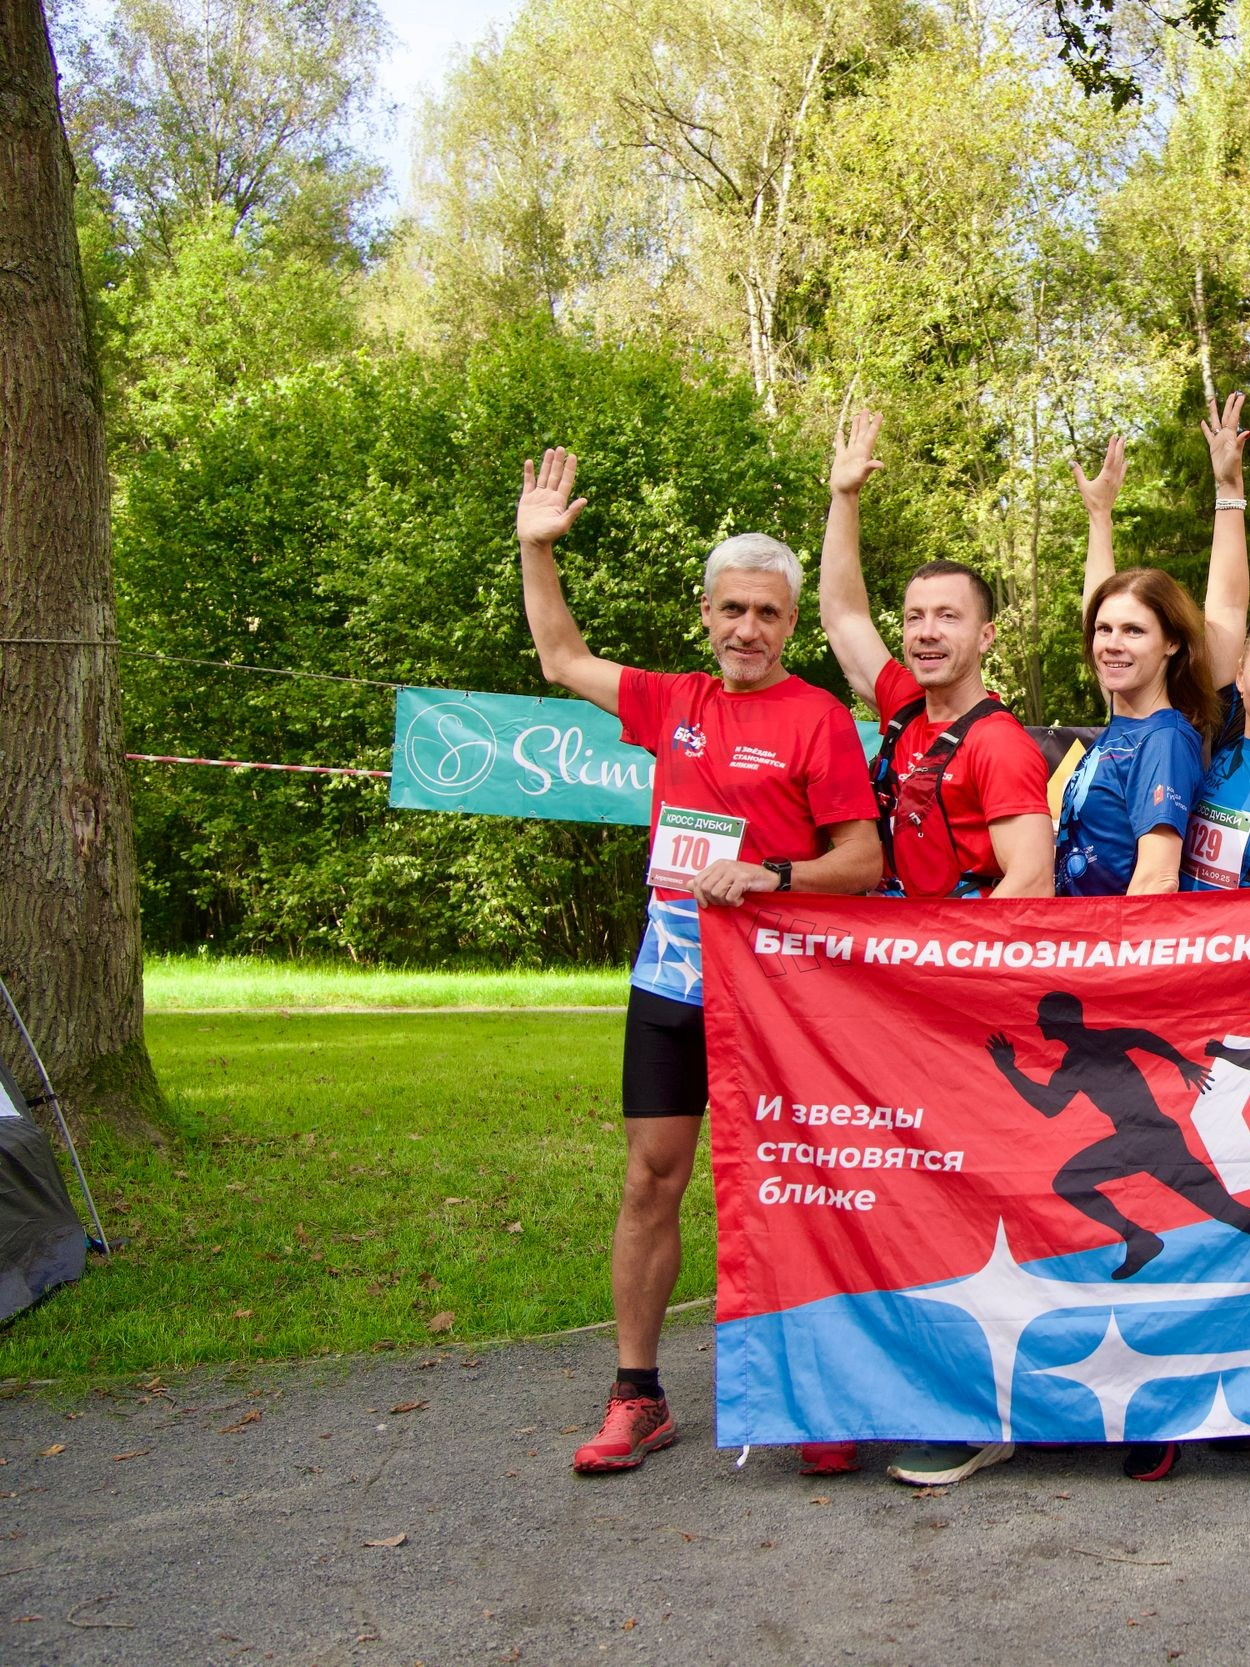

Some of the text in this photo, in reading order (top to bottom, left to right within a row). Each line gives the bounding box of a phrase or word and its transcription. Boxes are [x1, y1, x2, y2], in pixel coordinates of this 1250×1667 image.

[513, 725, 655, 795] Slim
[666, 813, 733, 832] КРОСС ДУБКИ
[1209, 809, 1242, 827] ДУБКИ
[671, 834, 710, 871] 170
[1191, 822, 1222, 862] 129
[1202, 868, 1231, 883] 14.09.25
[754, 928, 854, 961] БЕГИ
[756, 1094, 925, 1130] И звезды
[756, 1141, 965, 1172] становятся
[758, 1176, 876, 1211] ближе
